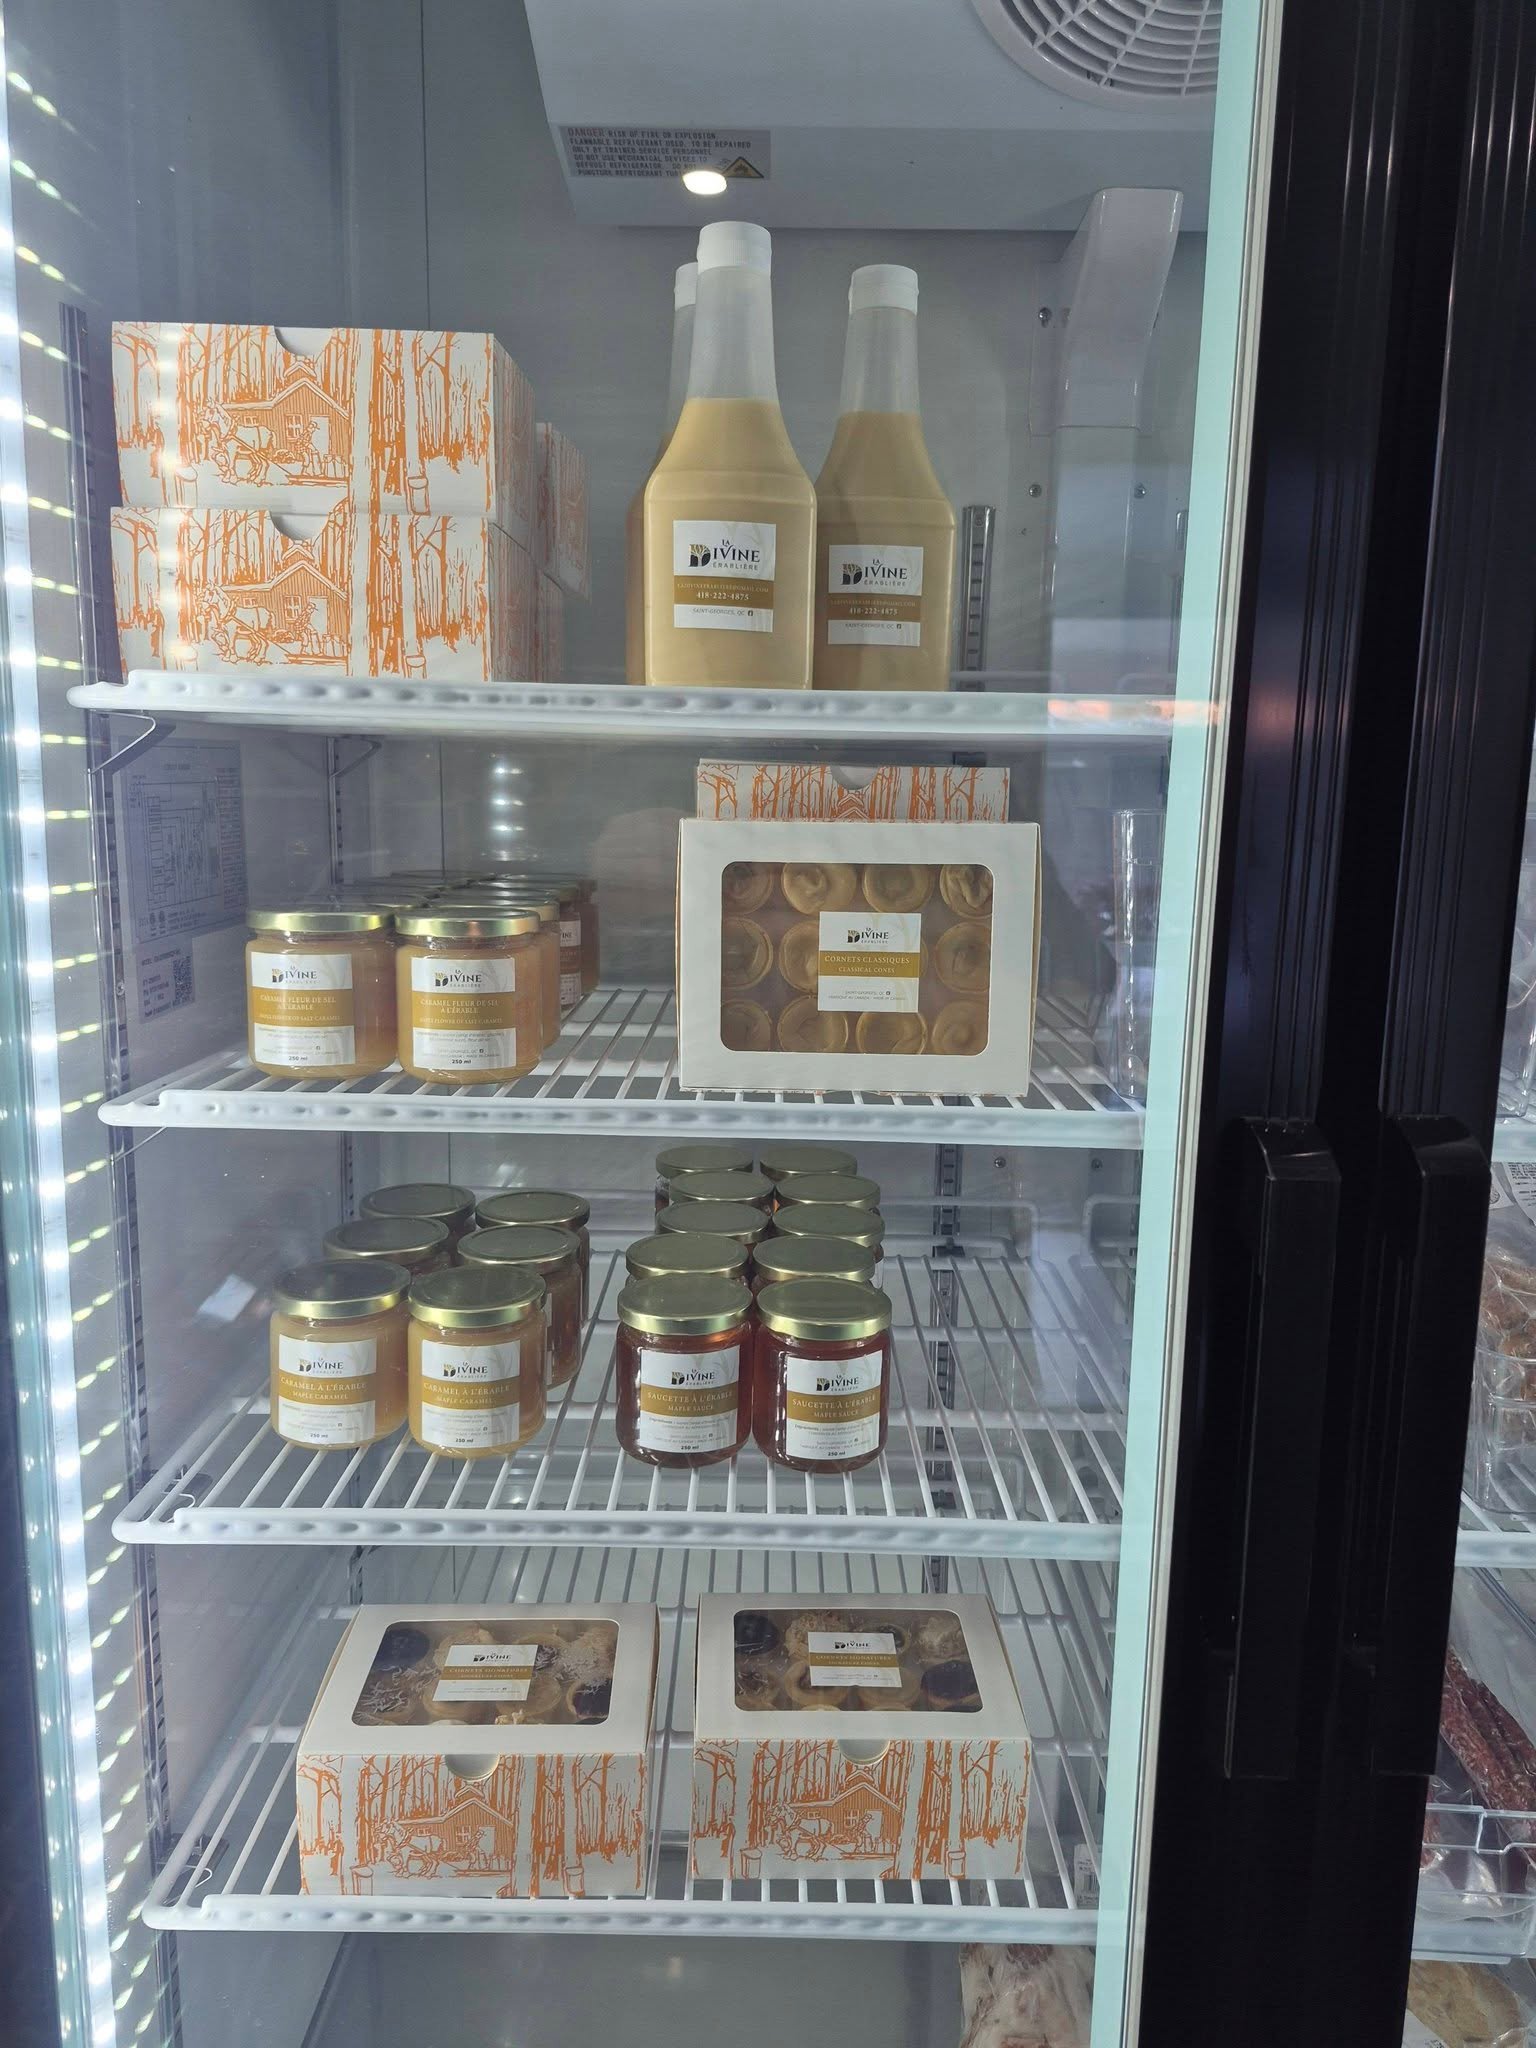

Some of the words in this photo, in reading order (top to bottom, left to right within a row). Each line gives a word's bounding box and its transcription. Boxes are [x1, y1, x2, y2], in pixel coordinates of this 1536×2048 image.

[568, 128, 604, 137] DANGER
[608, 130, 626, 138] RISK
[630, 130, 638, 138] OF
[641, 130, 658, 138] FIRE
[712, 561, 759, 571] ÉRABLIÈRE
[824, 955, 861, 963] CORNETS
[862, 956, 910, 965] CLASSIQUES
[838, 966, 872, 974] CLASSICAL
[288, 996, 311, 1004] FLEUR
[420, 999, 451, 1007] CARAMEL
[280, 1377, 315, 1390] CARAMEL
[317, 1383, 324, 1391] À
[326, 1382, 367, 1391] L'ÉRABLE
[424, 1382, 458, 1395] CARAMEL
[463, 1387, 468, 1395] À
[470, 1385, 510, 1395] L'ÉRABLE
[292, 1391, 312, 1399] MAPLE
[647, 1391, 689, 1403] SAUCETTE
[692, 1394, 697, 1403] À
[699, 1391, 733, 1403] L'ÉRABLE
[792, 1398, 835, 1409] SAUCETTE
[837, 1400, 842, 1409] À
[845, 1395, 876, 1408] L'ÉRABLE
